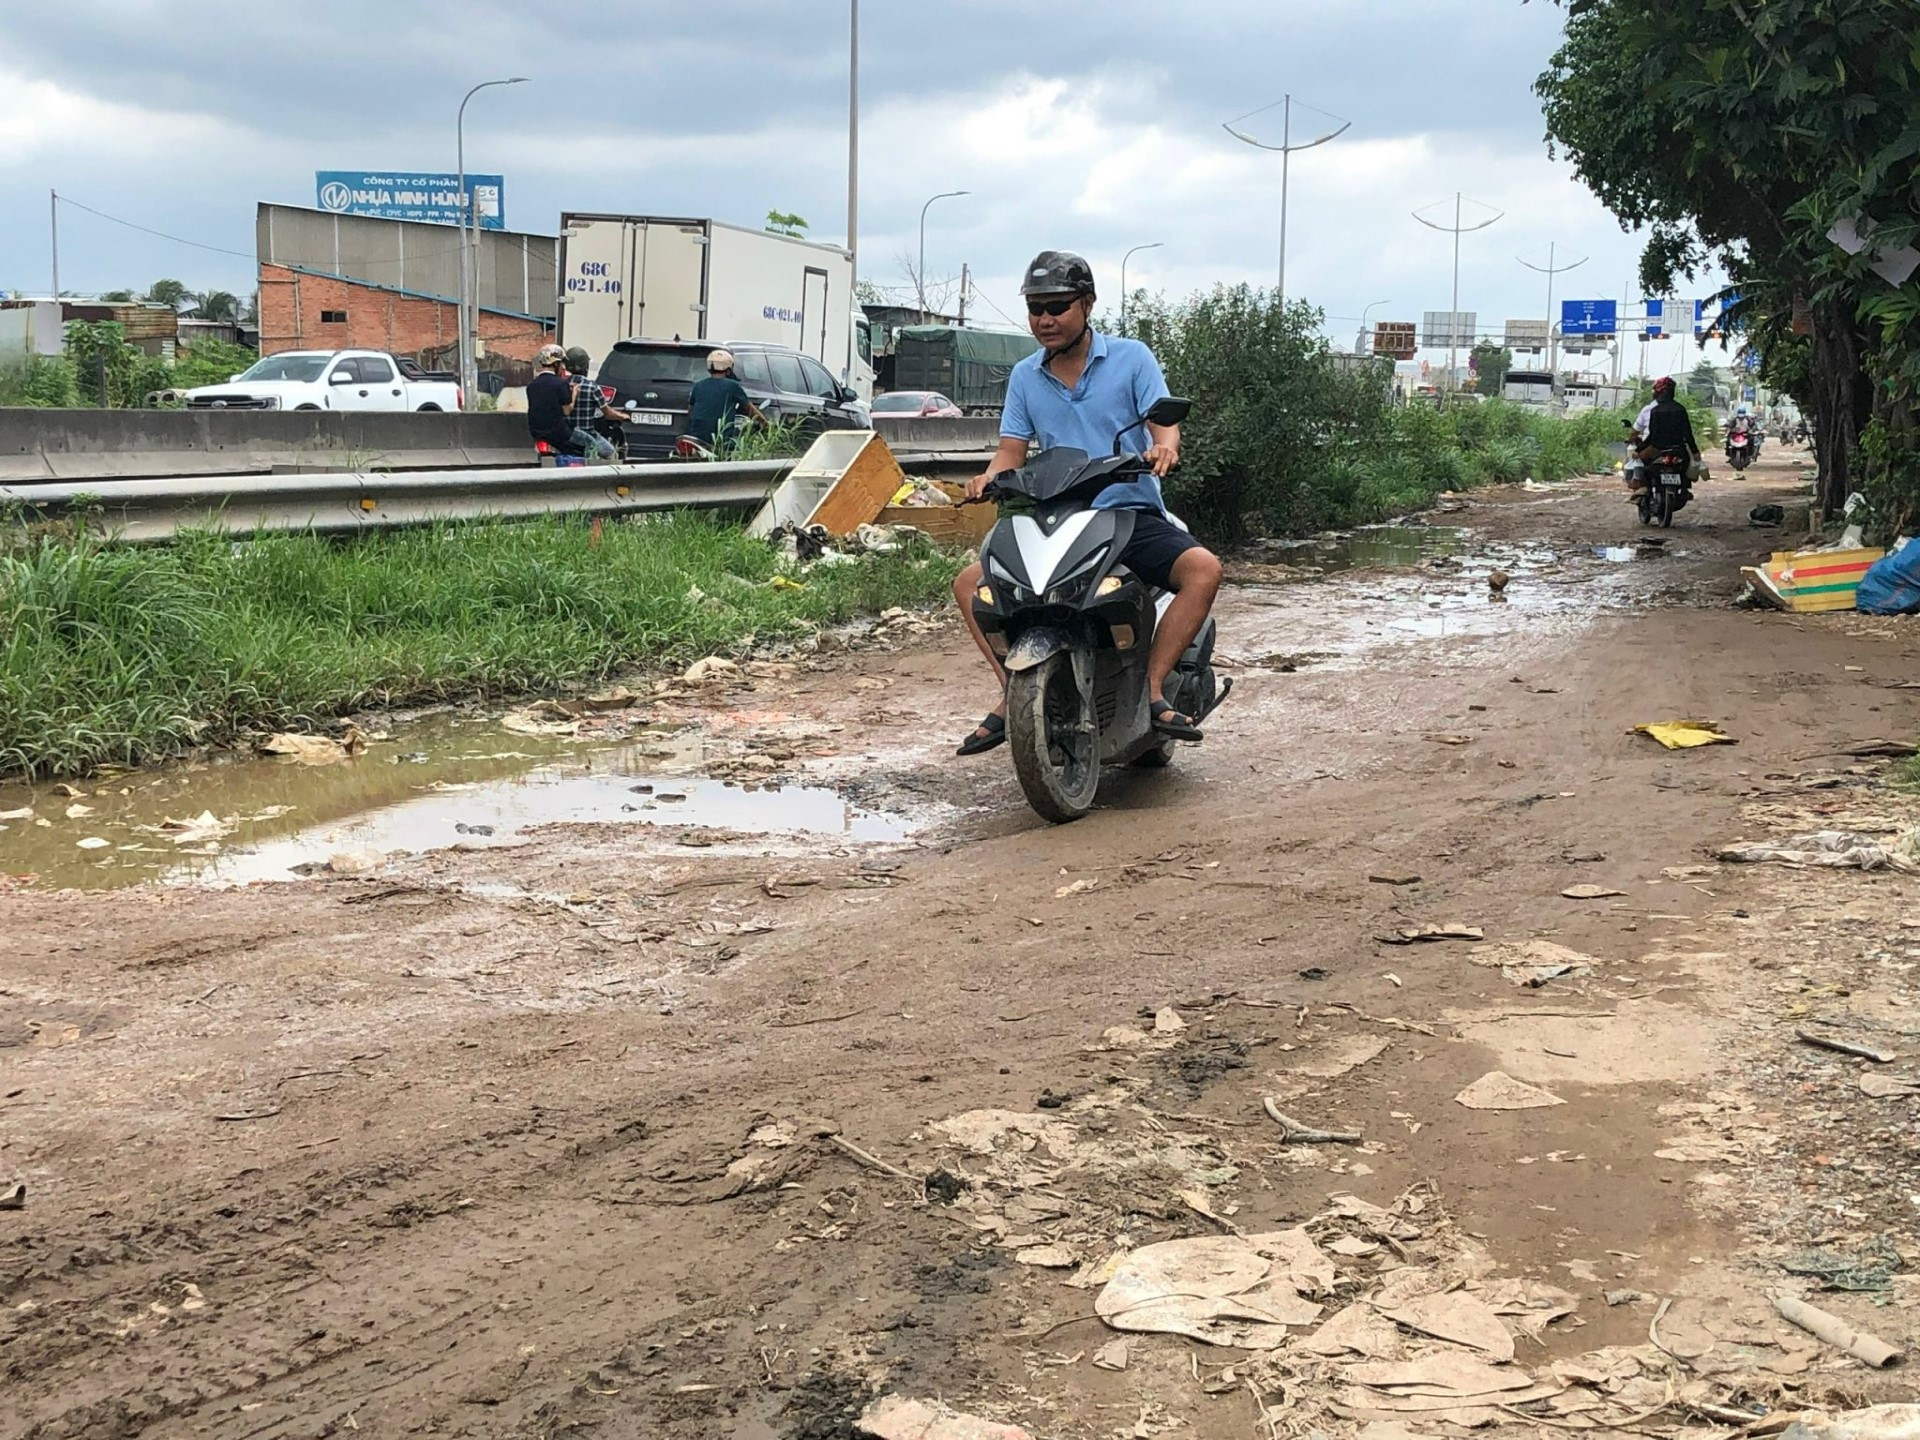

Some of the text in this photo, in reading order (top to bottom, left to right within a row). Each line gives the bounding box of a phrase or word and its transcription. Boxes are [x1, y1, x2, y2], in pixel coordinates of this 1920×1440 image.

[363, 176, 393, 186] CÔNG
[395, 178, 409, 186] TY
[429, 177, 458, 187] PHẦN
[352, 188, 469, 207] NHỰA MINH HÙNG
[580, 261, 611, 277] 68C
[567, 277, 621, 294] 021.40
